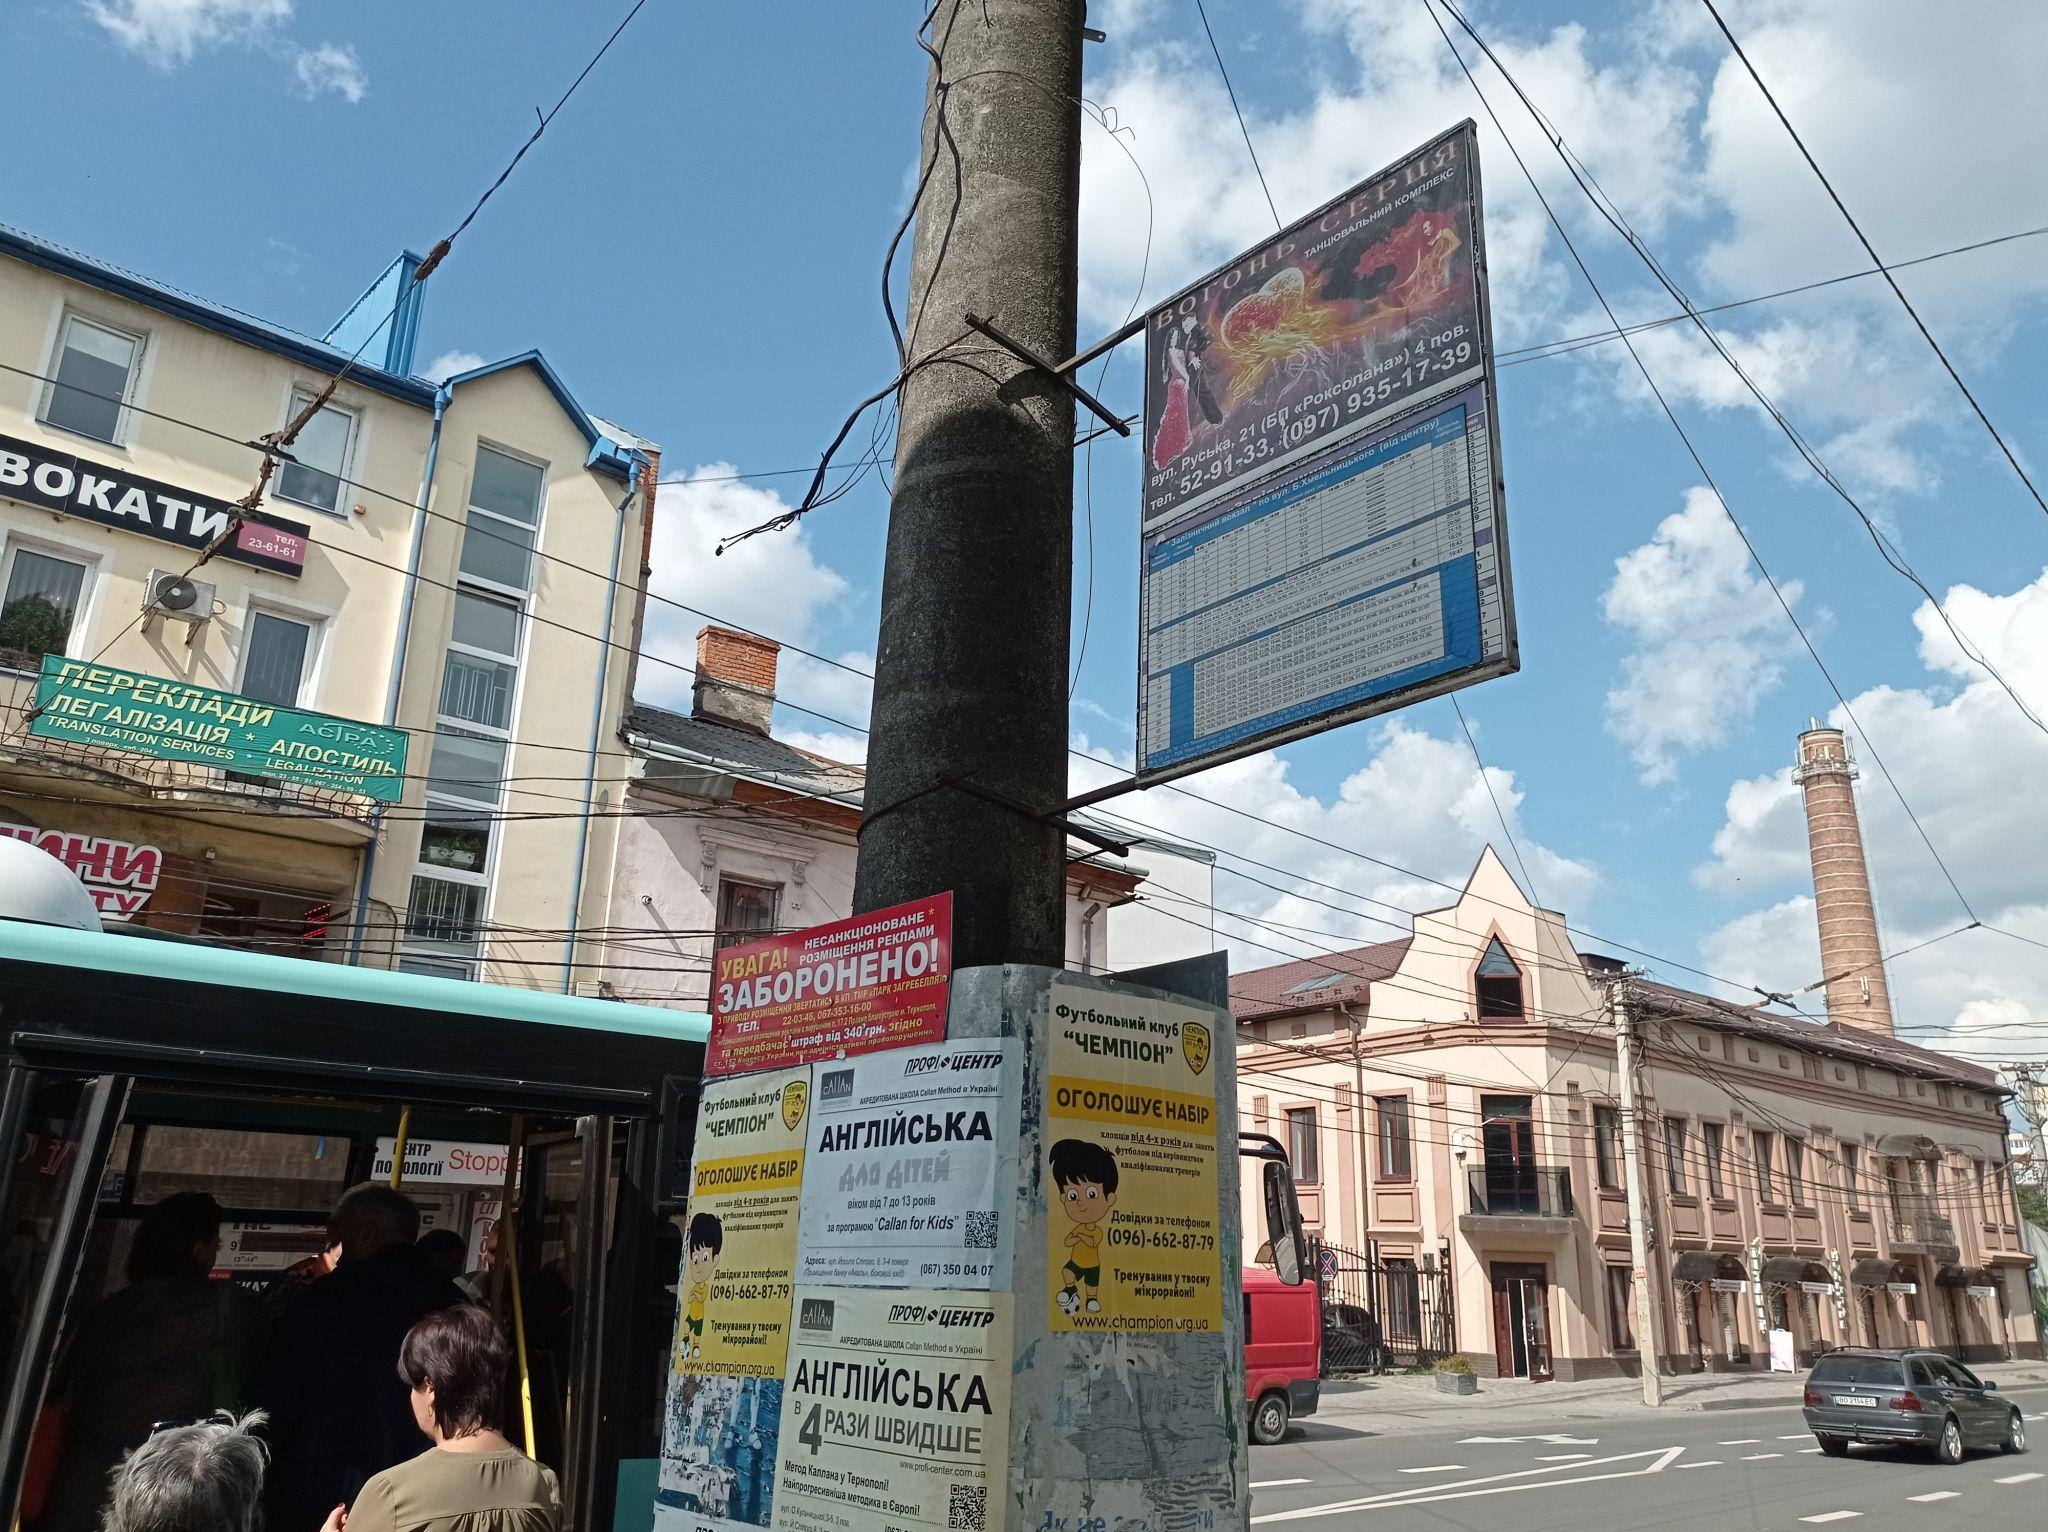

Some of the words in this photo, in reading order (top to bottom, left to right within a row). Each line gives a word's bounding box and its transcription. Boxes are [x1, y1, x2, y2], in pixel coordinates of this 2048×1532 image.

[1304, 203, 1393, 259] ТАНЦЮВАЛЬНИЙ
[1394, 167, 1455, 209] КОМПЛЕКС
[1155, 240, 1296, 331] ВОГОНЬ
[1319, 141, 1459, 233] СЕРЦЯ
[1151, 463, 1178, 487] вул.
[1181, 437, 1236, 470] Руська,
[1240, 424, 1257, 442] 21
[1261, 406, 1289, 435] (БП
[1414, 340, 1426, 357] 4
[1430, 324, 1469, 349] пов.
[1149, 488, 1176, 511] тел.
[1180, 437, 1275, 496] 52-91-33,
[1282, 402, 1340, 451] (097)
[1346, 341, 1472, 415] 935-17-39
[247, 537, 297, 558] 23-61-61
[275, 533, 299, 548] тел.
[54, 662, 276, 728] ПЕРЕКЛАДИ
[47, 715, 159, 746] TRANSLATION
[161, 737, 236, 760] SERVICES
[265, 757, 365, 785] LEGALIZATION
[48, 694, 231, 745] ЛЕГАЛІЗАЦІЯ
[268, 739, 398, 777] АПОСТИЛЬ
[299, 722, 378, 748] АСТРА
[799, 939, 875, 966] РОЗМІЩЕННЯ
[877, 924, 935, 949] РЕКЛАМИ
[804, 911, 925, 951] НЕСАНКЦІОНОВАНЕ
[717, 937, 939, 1014] ЗАБОРОНЕНО!
[720, 946, 789, 982] УВАГА!
[723, 1011, 751, 1024] ПРИВОДУ
[751, 1003, 792, 1020] РОЗМІЩЕННЯ
[840, 993, 851, 1004] КП
[853, 988, 869, 1001] ТМР
[736, 1020, 760, 1034] ТЕЛ.
[818, 1002, 872, 1020] 067-353-16-00
[795, 1032, 829, 1050] штраф
[831, 1029, 842, 1042] від
[843, 1025, 861, 1041] 340
[864, 1023, 886, 1037] грн.
[888, 1017, 924, 1032] згідно
[1055, 1004, 1146, 1031] Футбольний
[1150, 1020, 1179, 1039] клуб
[1063, 1030, 1173, 1064] “ЧЕМПІОН”
[905, 1055, 940, 1074] ПРОФІ
[951, 1054, 1004, 1073] ЦЕНТР
[704, 1093, 757, 1114] Футбольний
[758, 1089, 781, 1107] клуб
[859, 1094, 899, 1106] АКРЕДИТОВАНА
[899, 1091, 920, 1100] ШКОЛА
[920, 1088, 937, 1098] Callan
[937, 1086, 962, 1095] Method
[969, 1084, 998, 1095] Україні
[1056, 1087, 1162, 1118] ОГОЛОШУЄ
[1165, 1101, 1210, 1125] НАБІР
[818, 1109, 993, 1153] АНГЛІЙСЬКА
[1130, 1132, 1145, 1144] від
[1145, 1133, 1160, 1145] 4-х
[1160, 1135, 1182, 1148] років
[1114, 1146, 1151, 1158] футболом
[1151, 1150, 1163, 1160] під
[697, 1162, 758, 1187] ОГОЛОШУЄ
[760, 1159, 798, 1180] НАБІР
[838, 1160, 882, 1193] ДЛЯ
[885, 1148, 951, 1190] ДІТЕЙ
[847, 1198, 869, 1210] віком
[869, 1197, 882, 1210] від
[883, 1196, 889, 1208] 7
[889, 1198, 900, 1210] до
[902, 1195, 911, 1207] 13
[912, 1194, 936, 1209] років
[827, 1224, 835, 1232] за
[836, 1222, 874, 1234] програмою
[909, 1216, 926, 1231] for
[1111, 1210, 1153, 1225] Довідки
[1154, 1216, 1166, 1226] за
[1166, 1217, 1211, 1230] телефоном
[1107, 1227, 1214, 1251] (096)-662-87-79
[714, 1269, 741, 1280] Довідки
[742, 1271, 749, 1279] за
[750, 1268, 788, 1282] телефоном
[805, 1256, 827, 1266] Адреса:
[920, 1263, 941, 1277] (067)
[943, 1263, 961, 1275] 350
[963, 1265, 978, 1276] 04
[980, 1264, 994, 1276] 07
[1113, 1268, 1173, 1286] Тренування
[1174, 1275, 1180, 1286] у
[1182, 1274, 1210, 1287] твоєму
[710, 1284, 790, 1301] (096)-662-87-79
[1134, 1284, 1195, 1300] мікрорайоні!
[711, 1320, 751, 1335] Тренування
[888, 1304, 927, 1322] ПРОФІ
[939, 1309, 995, 1329] ЦЕНТР
[722, 1334, 767, 1347] мікрорайоні!
[840, 1335, 883, 1348] АКРЕДИТОВАНА
[883, 1339, 905, 1350] ШКОЛА
[905, 1341, 923, 1351] Callan
[924, 1342, 947, 1352] Method
[955, 1343, 983, 1355] Україні
[792, 1358, 993, 1415] АНГЛІЙСЬКА
[798, 1403, 822, 1456] 4
[825, 1408, 870, 1440] РАЗИ
[874, 1415, 983, 1456] ШВИДШЕ
[784, 1459, 807, 1476] Метод
[808, 1464, 839, 1481] Каллана
[847, 1471, 890, 1492] Тернополі!
[900, 1460, 986, 1479] www.profi-center.com.ua
[783, 1477, 846, 1500] Найпрогресивніша
[847, 1492, 881, 1509] методика
[889, 1499, 921, 1516] Європі!
